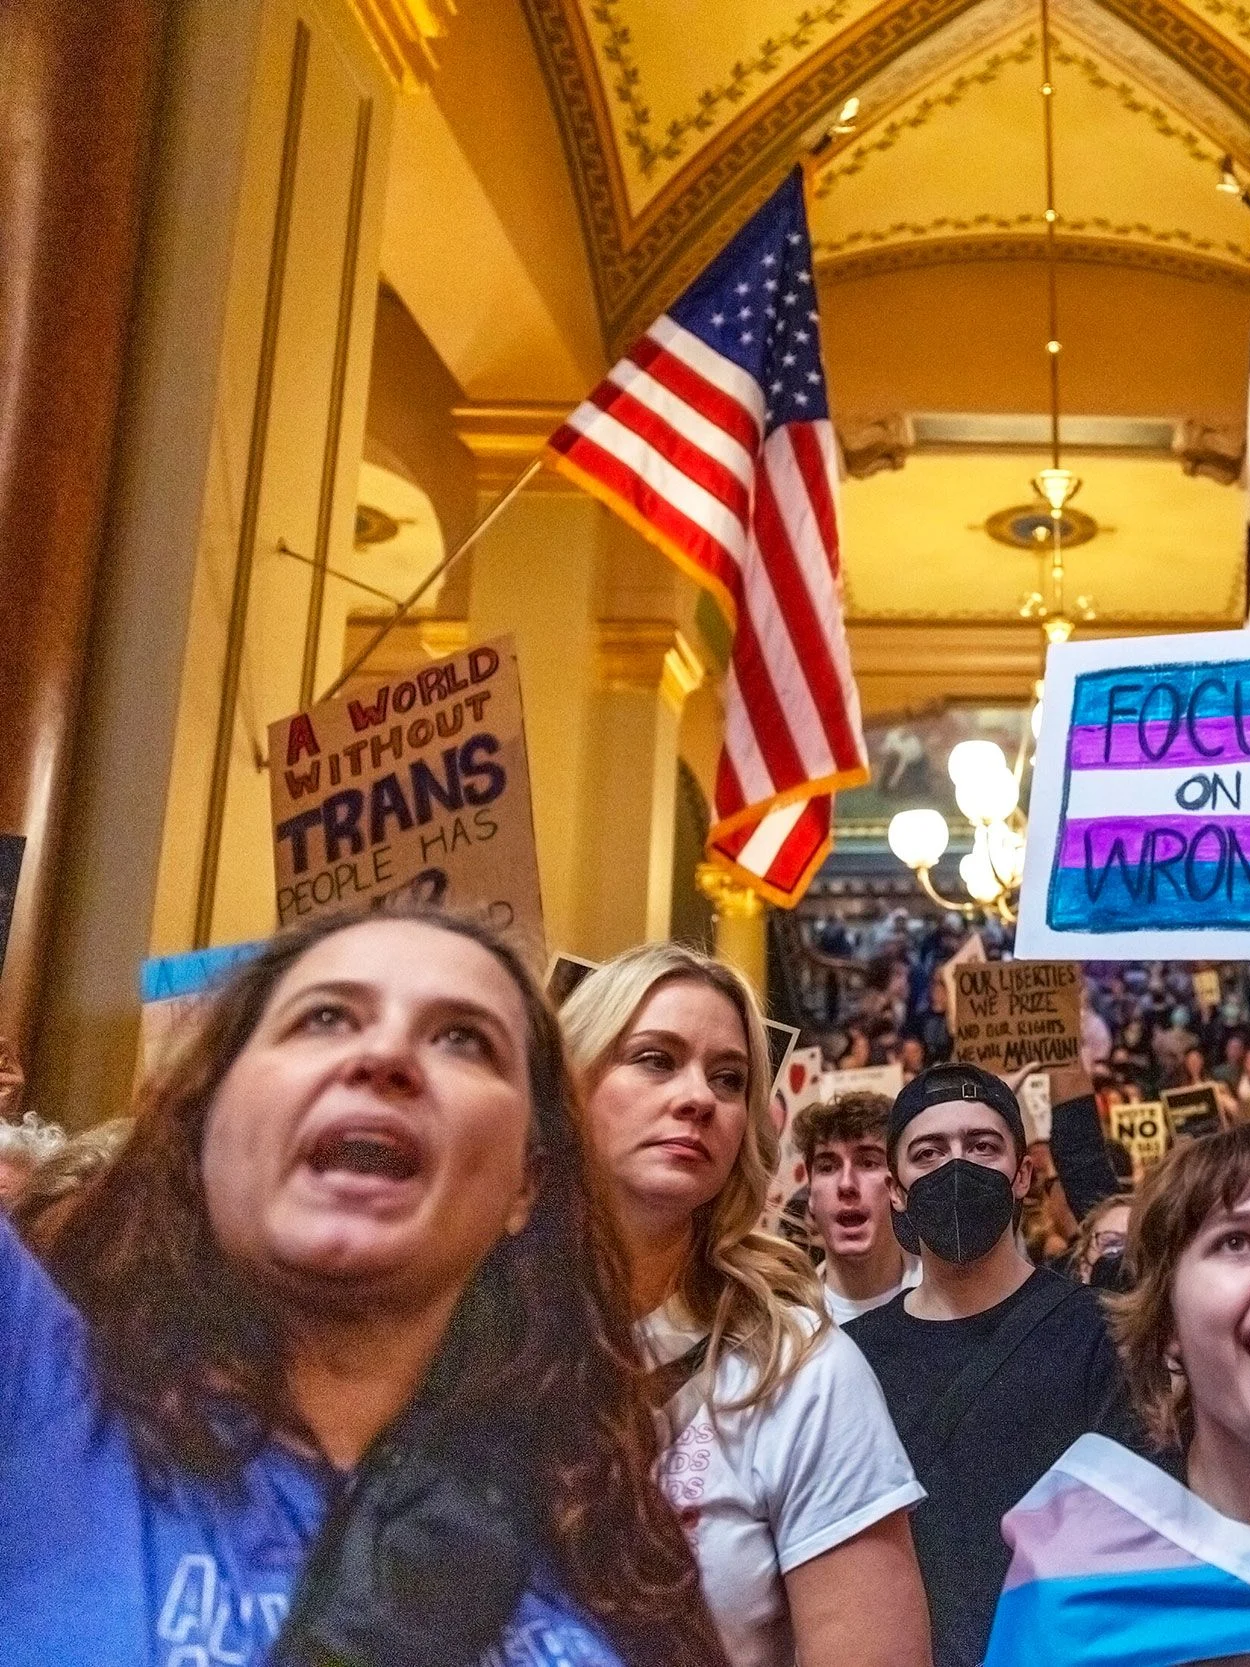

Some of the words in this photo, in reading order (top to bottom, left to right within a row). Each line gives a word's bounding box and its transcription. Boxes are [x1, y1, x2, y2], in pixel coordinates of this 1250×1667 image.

[285, 712, 321, 766] A
[347, 646, 500, 733] WORLD
[284, 690, 492, 801] WITHOUT
[275, 732, 508, 876] TRANS
[1175, 769, 1242, 812] ON
[276, 846, 392, 926] PEOPLE
[418, 808, 499, 864] HAS
[960, 970, 998, 1000] OUR
[999, 964, 1077, 991] LIBERTIES
[969, 997, 999, 1017] WE
[1007, 989, 1059, 1017] PRIZE
[957, 1022, 981, 1041] AND
[985, 1021, 1014, 1038] OUR
[1016, 1018, 1067, 1037] RIGHTS
[1117, 1119, 1158, 1139] NO
